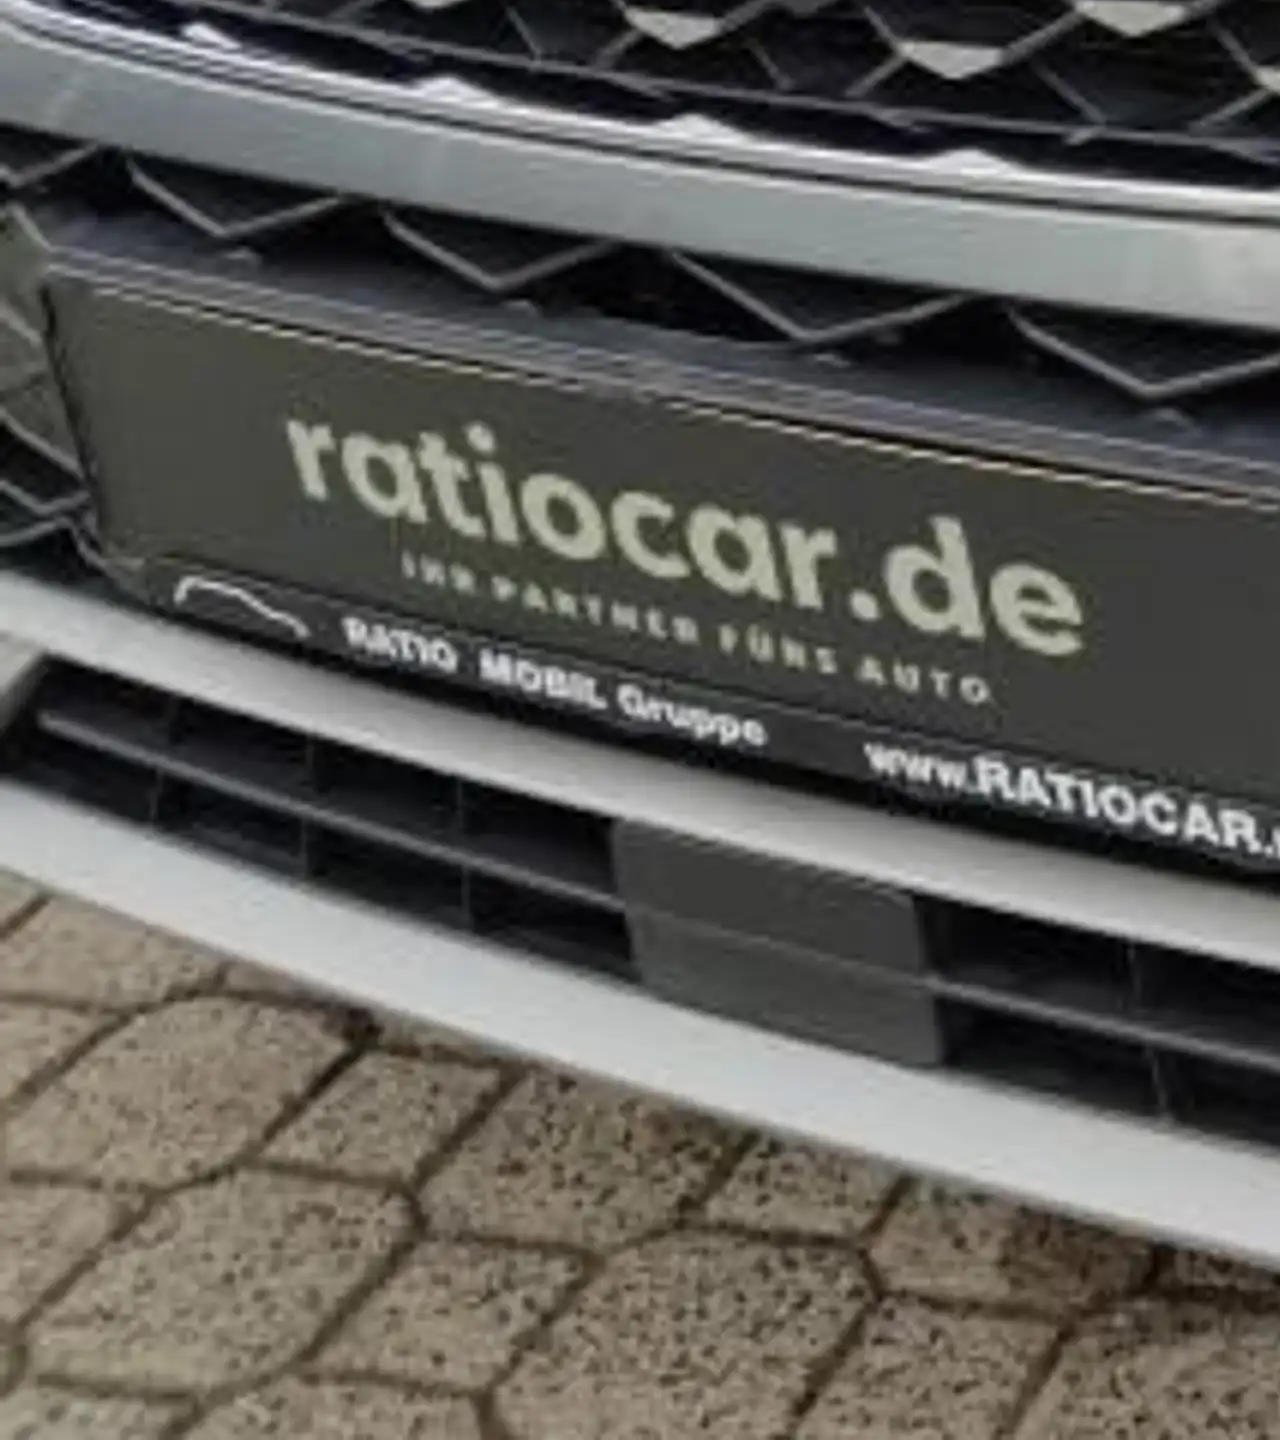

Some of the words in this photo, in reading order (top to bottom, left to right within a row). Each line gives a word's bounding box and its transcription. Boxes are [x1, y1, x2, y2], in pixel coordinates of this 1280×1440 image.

[286, 419, 1085, 657] ratiocar.de
[341, 616, 458, 674] RATIO
[479, 648, 608, 709] MOBIL
[617, 684, 769, 747] Gruppe
[491, 573, 699, 645] PARTNER
[856, 655, 992, 707] AUTO
